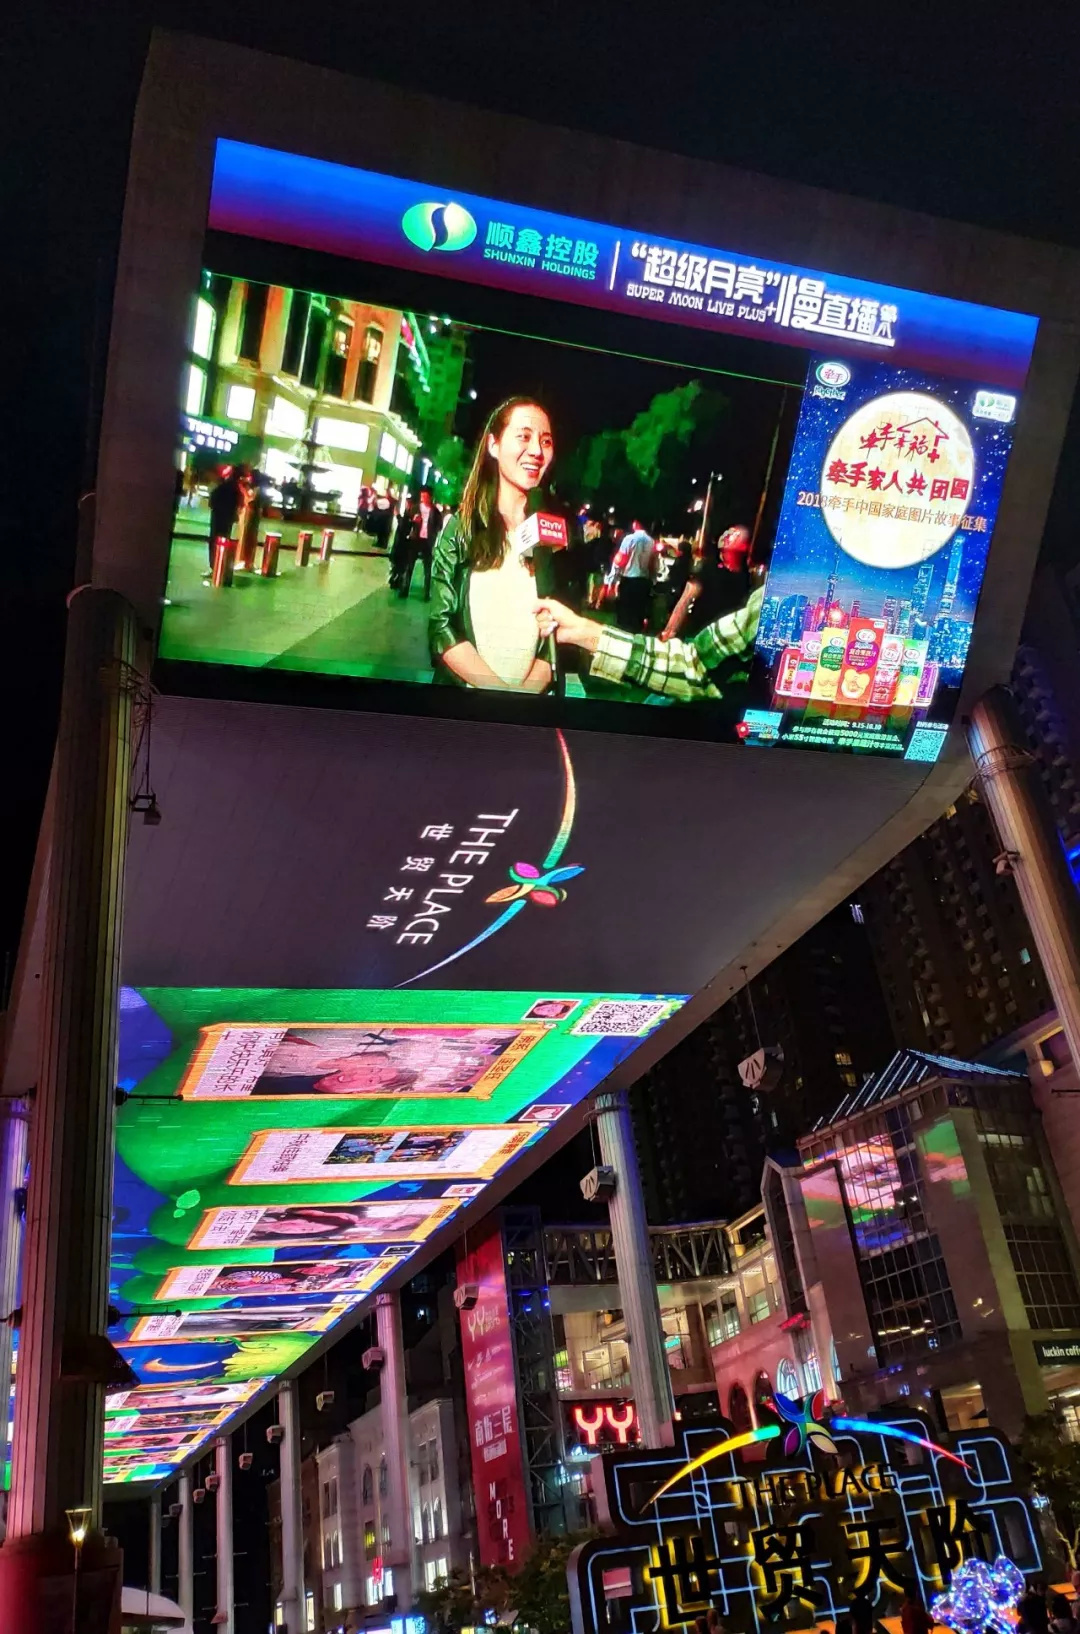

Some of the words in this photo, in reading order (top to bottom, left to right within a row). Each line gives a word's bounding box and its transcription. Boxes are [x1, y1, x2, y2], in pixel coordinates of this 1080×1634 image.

[483, 248, 536, 268] SHUNXIN
[541, 260, 596, 280] HOLDINGS
[485, 221, 599, 268] 顺鑫控股
[626, 283, 665, 302] SUPER
[668, 292, 704, 310] MOON
[707, 299, 735, 317] LIVE
[796, 491, 988, 533] 2018牵手中国家庭图片故事征集
[449, 808, 519, 865] THE
[366, 823, 453, 930] 世贸天阶
[396, 873, 474, 945] PLACE
[1041, 1345, 1065, 1357] luckin
[732, 1475, 795, 1508] THE
[803, 1462, 900, 1501] PLACE
[489, 1481, 514, 1561] MORE
[646, 1498, 992, 1625] 世贸天阶
